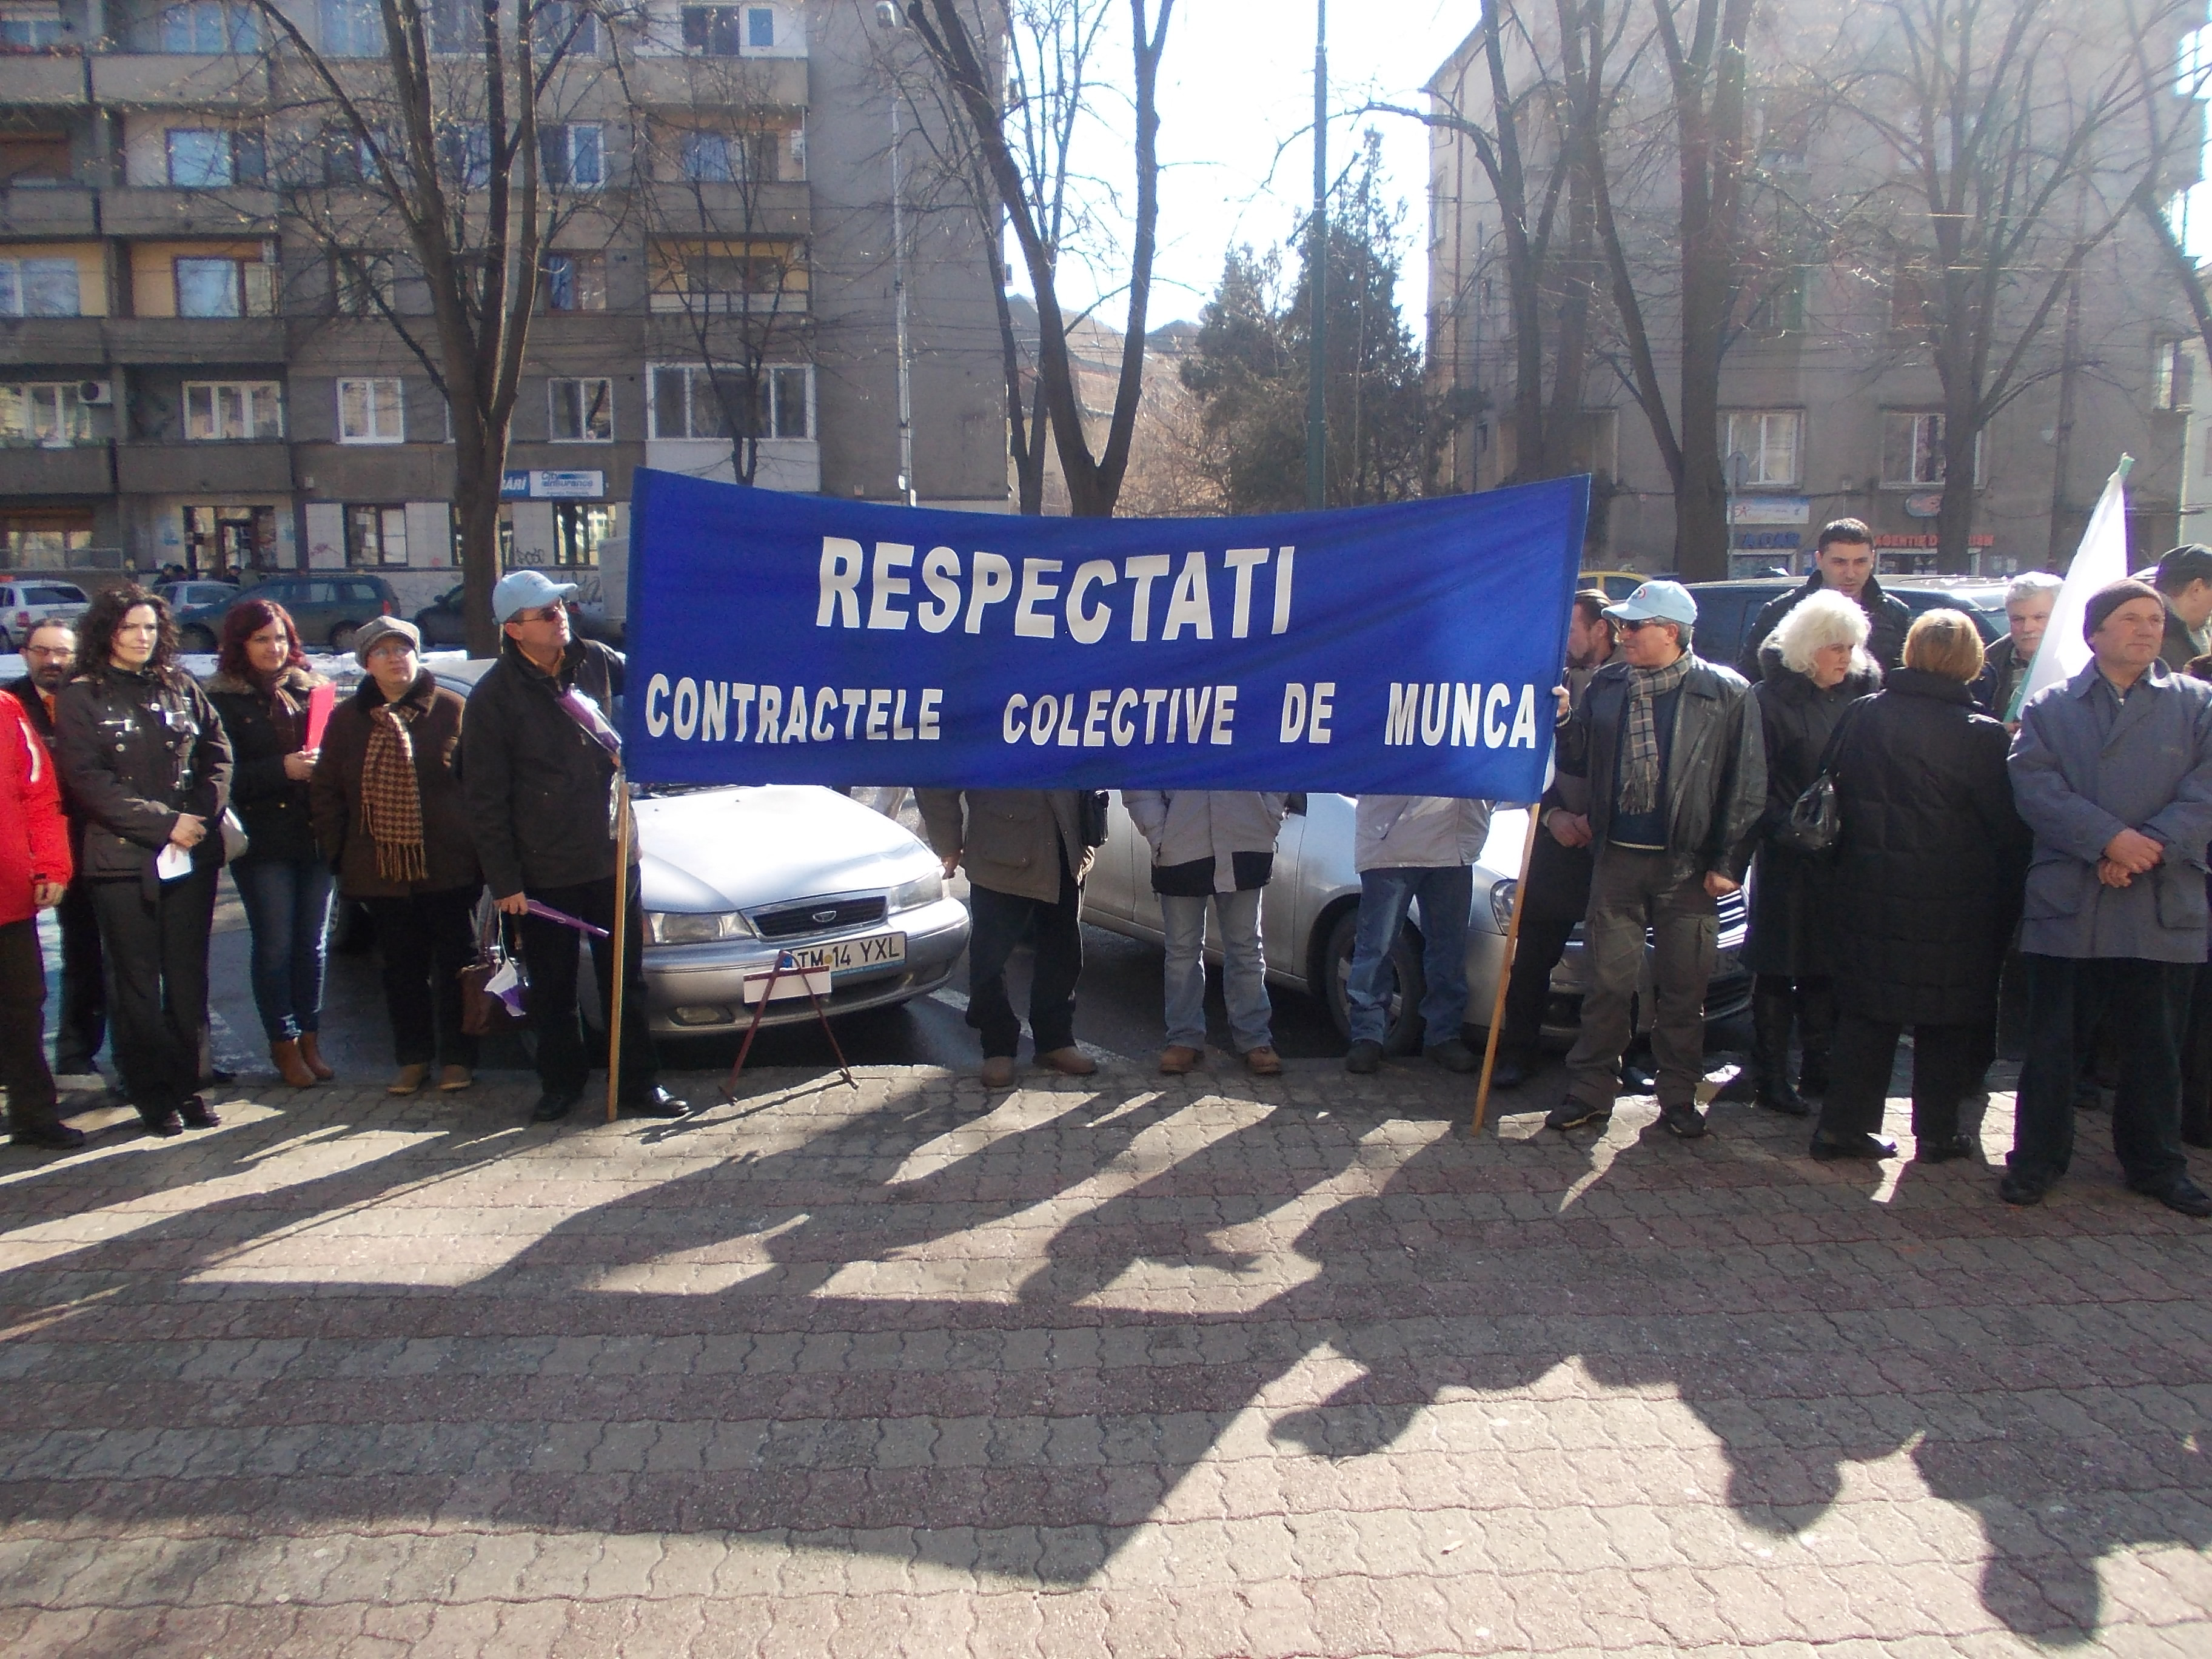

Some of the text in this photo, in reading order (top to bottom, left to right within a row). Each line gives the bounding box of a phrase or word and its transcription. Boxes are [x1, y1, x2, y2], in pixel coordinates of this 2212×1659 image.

[816, 536, 1295, 644] RESPECTATI
[645, 673, 1536, 748] CONTRACTELE COLECTIVE DE MUNCA
[797, 937, 900, 968] TM 14 YXL
